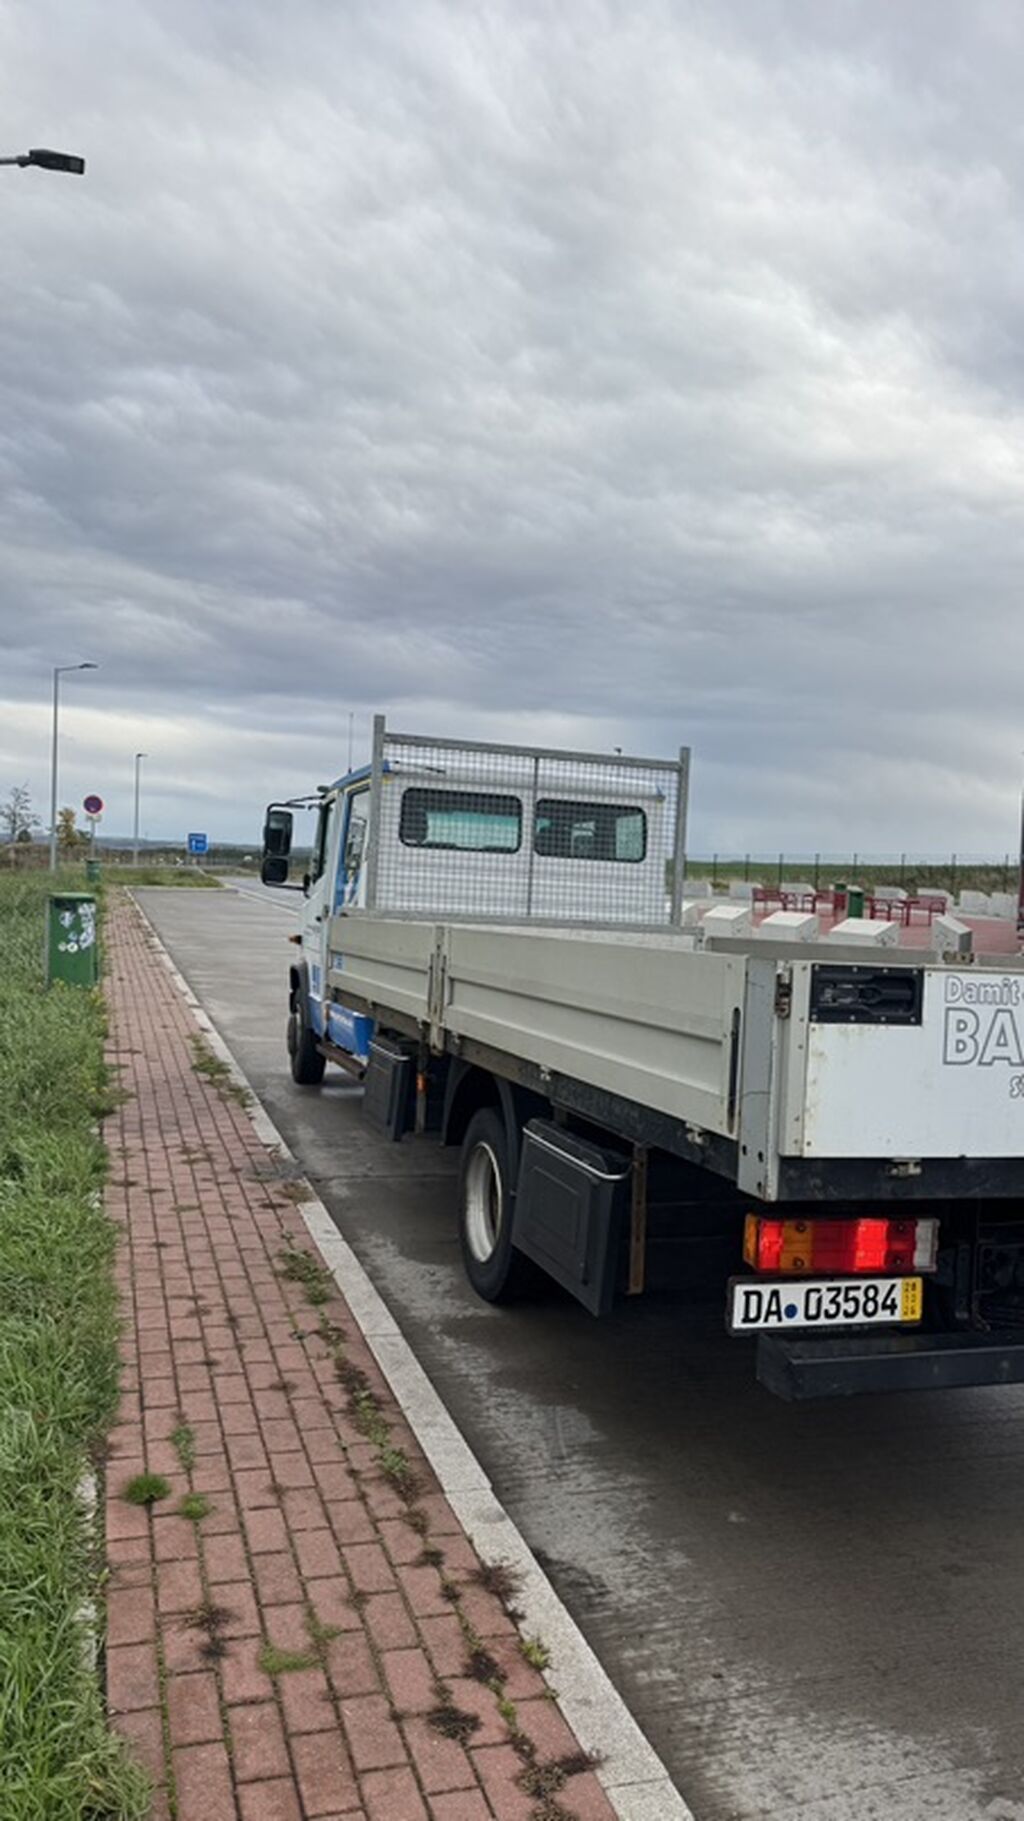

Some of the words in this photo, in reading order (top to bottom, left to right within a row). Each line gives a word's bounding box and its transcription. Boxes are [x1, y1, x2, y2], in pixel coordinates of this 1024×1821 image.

[944, 975, 1020, 1006] Damit
[741, 1289, 783, 1323] DA
[804, 1283, 898, 1321] 03584
